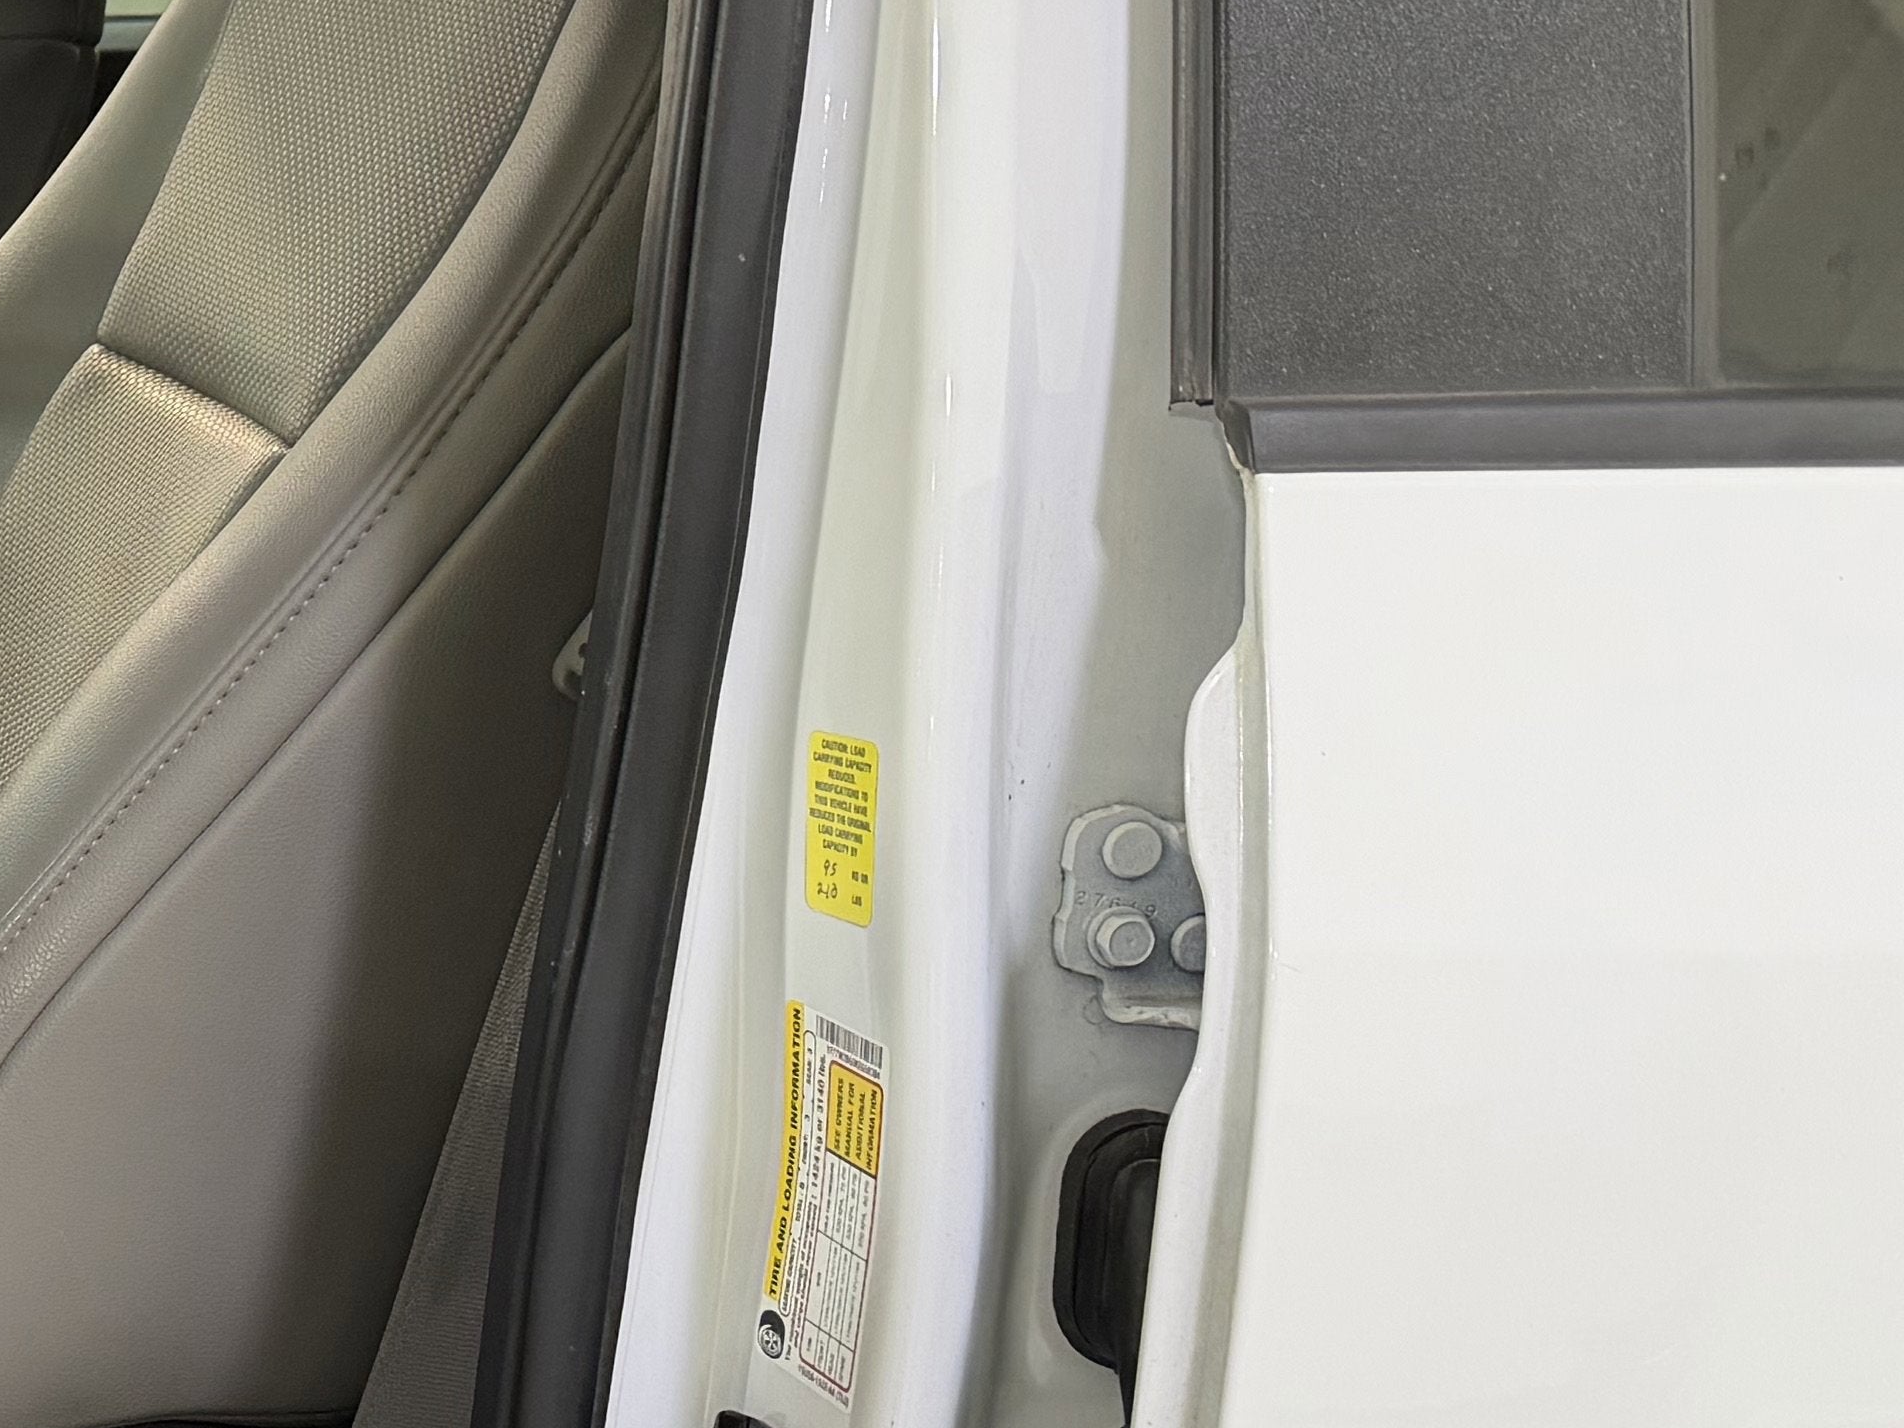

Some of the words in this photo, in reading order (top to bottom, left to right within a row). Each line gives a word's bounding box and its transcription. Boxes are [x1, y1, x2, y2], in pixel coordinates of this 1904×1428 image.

[769, 1256, 782, 1296] TIRE
[776, 1216, 787, 1253] AND
[782, 1135, 797, 1211] LOADING
[790, 1007, 801, 1129] INFORMATION
